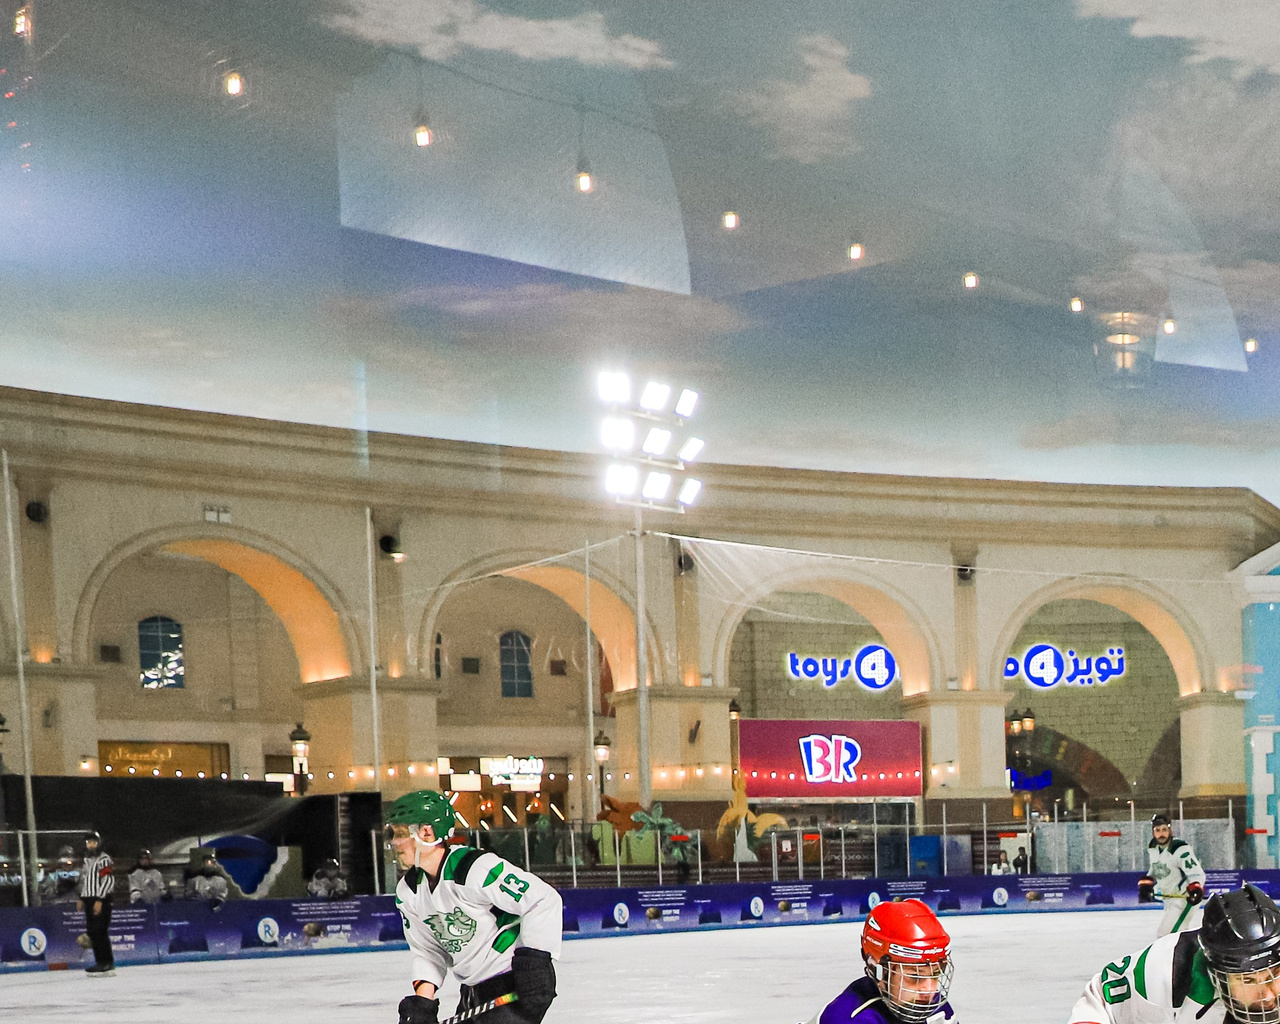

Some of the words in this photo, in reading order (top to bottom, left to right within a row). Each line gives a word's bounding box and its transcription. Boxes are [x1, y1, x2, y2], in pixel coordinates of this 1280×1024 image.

[799, 734, 862, 784] BR
[499, 873, 531, 903] 13
[1100, 955, 1132, 1005] 20
